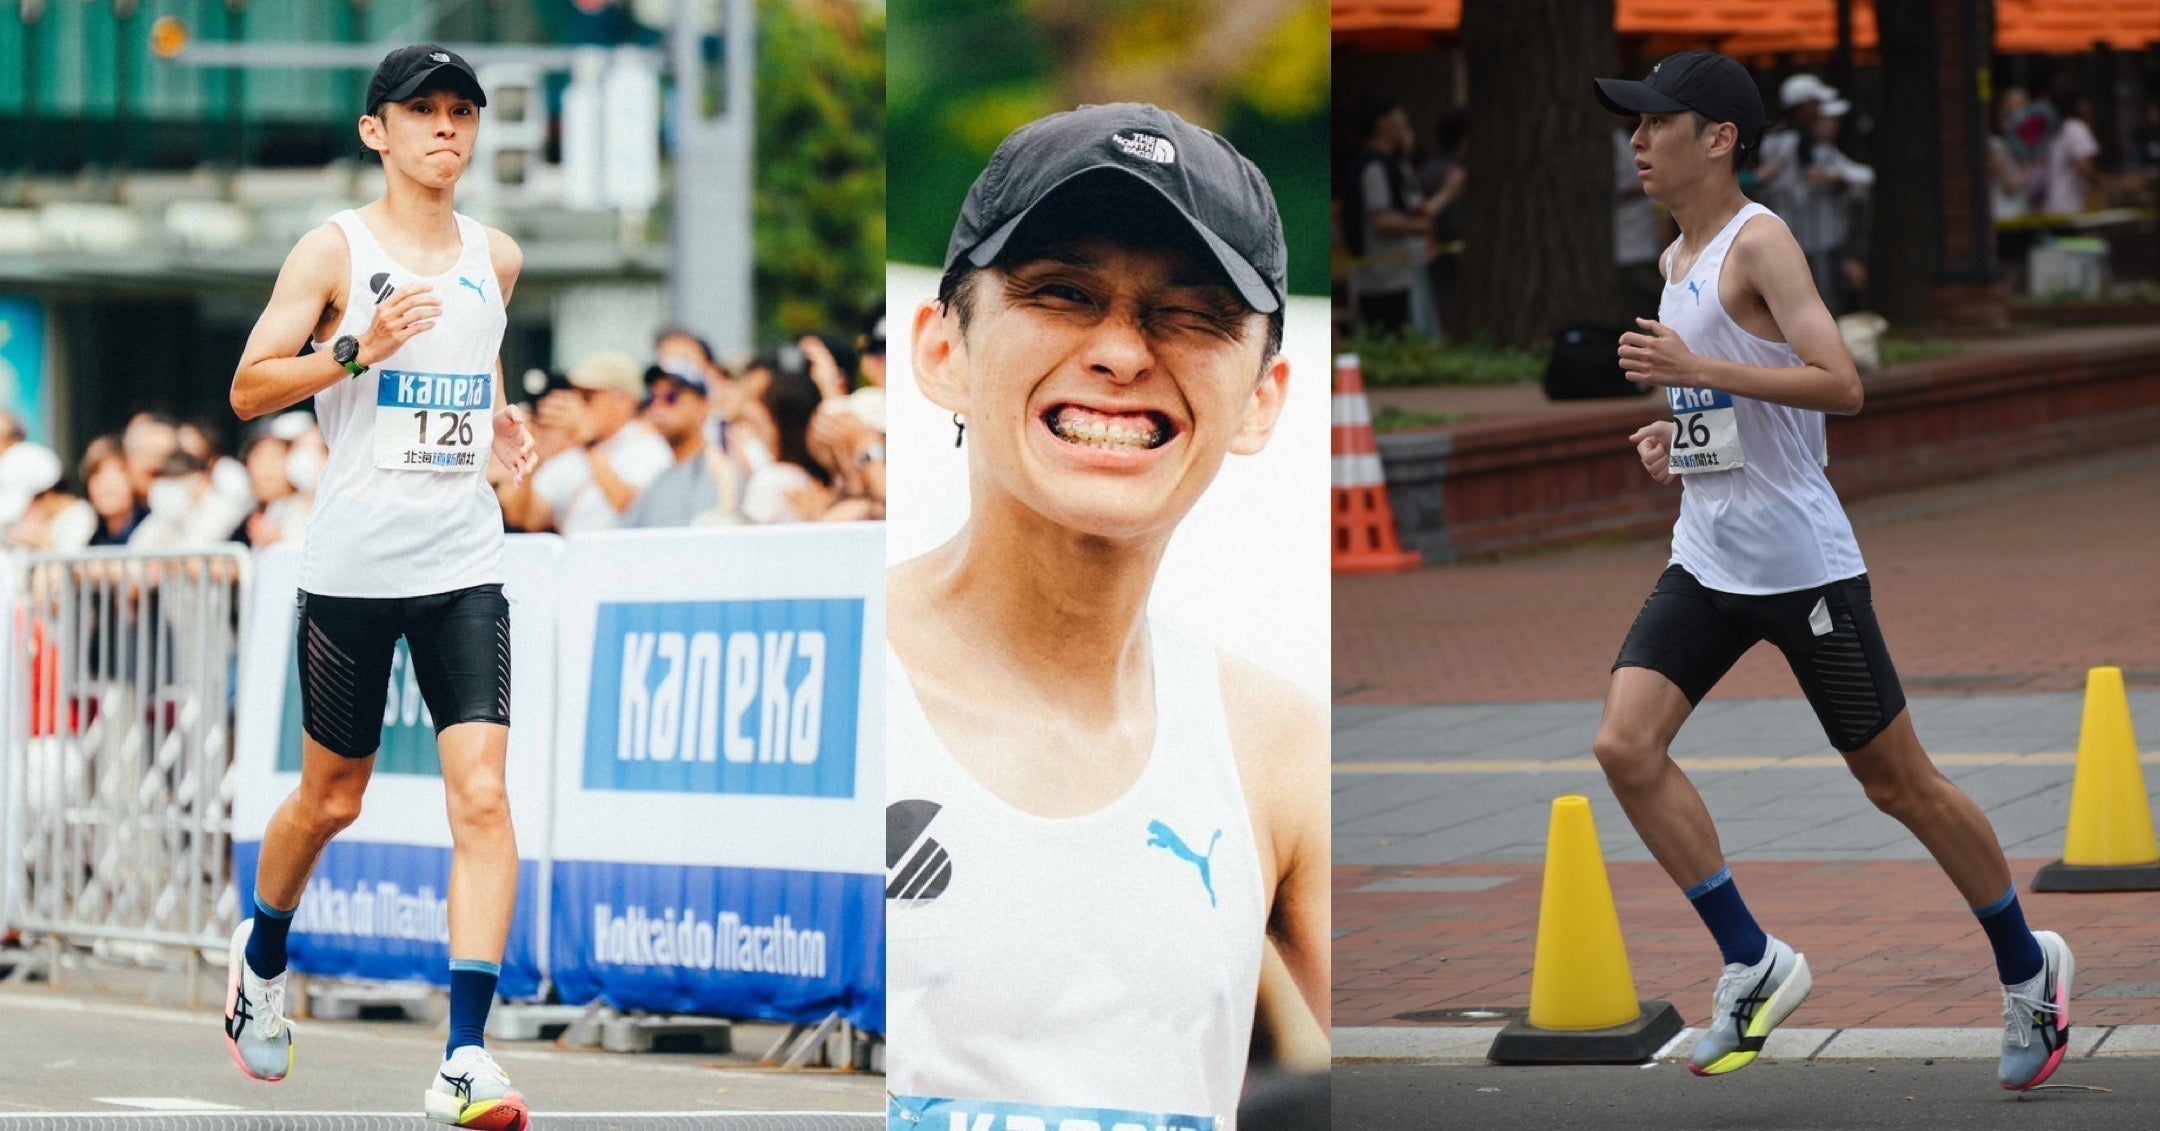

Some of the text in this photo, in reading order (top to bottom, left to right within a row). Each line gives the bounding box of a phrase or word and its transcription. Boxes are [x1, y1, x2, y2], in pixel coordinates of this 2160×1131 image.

[413, 410, 473, 446] 126
[403, 450, 476, 467] 北海道新聞社
[594, 902, 826, 978] Hokkaido Marathon
